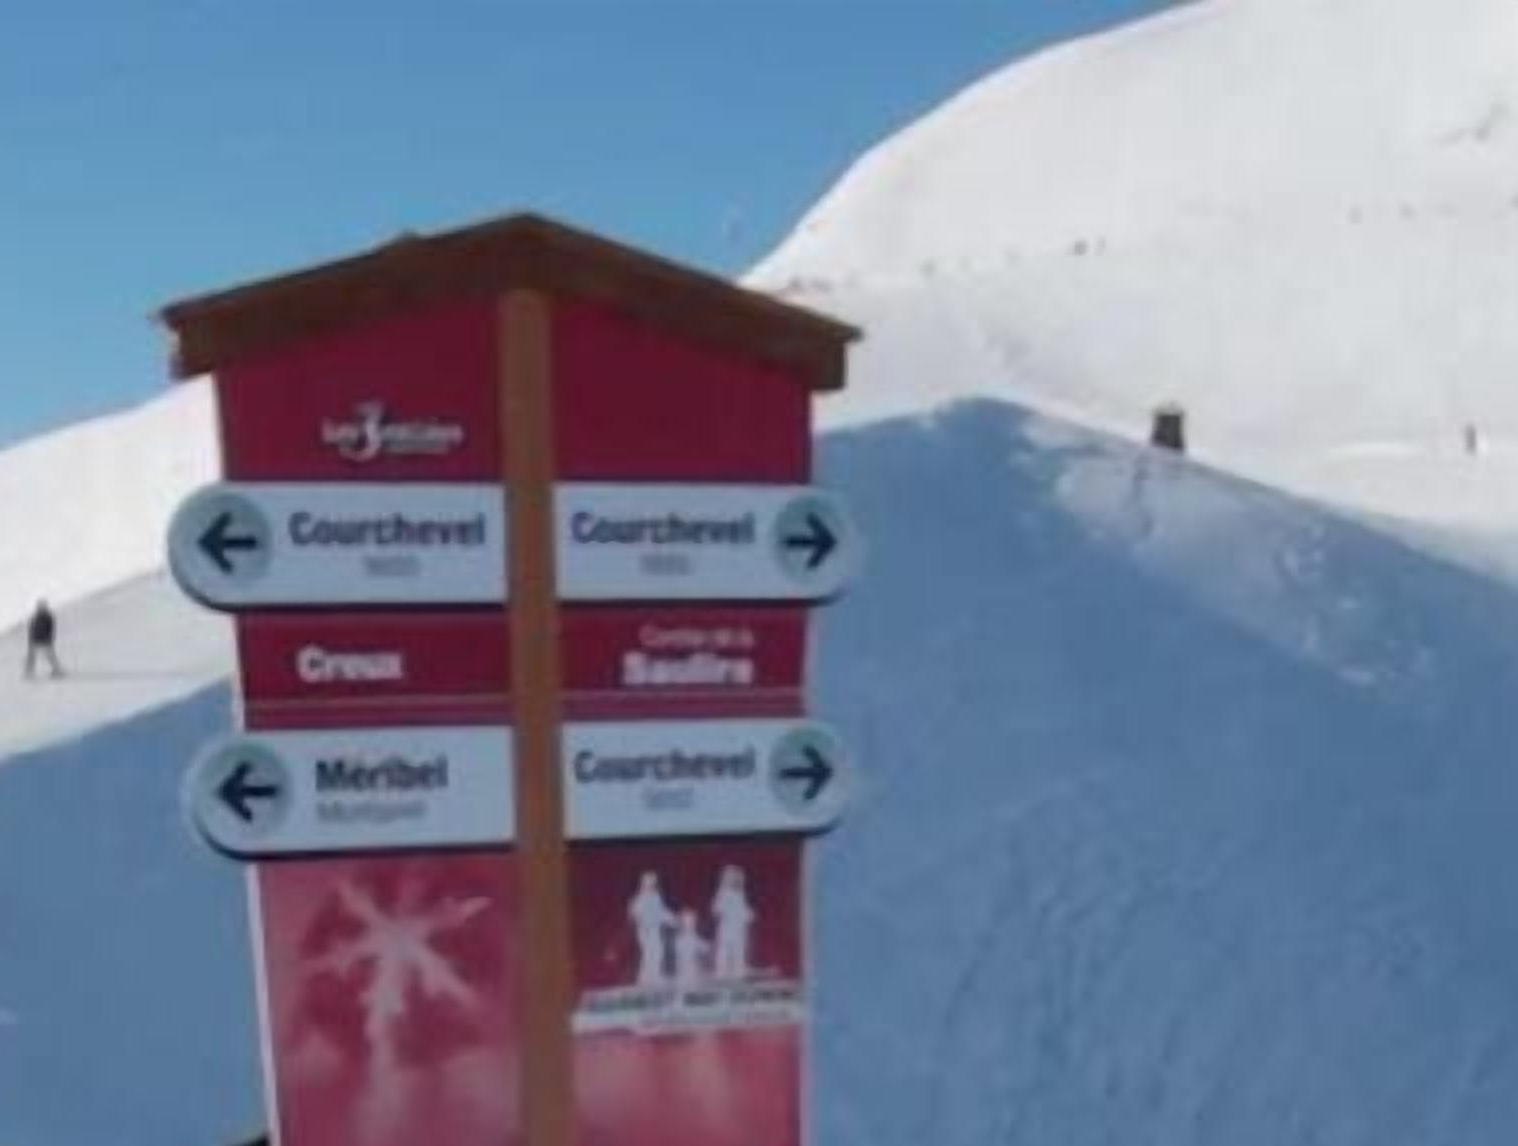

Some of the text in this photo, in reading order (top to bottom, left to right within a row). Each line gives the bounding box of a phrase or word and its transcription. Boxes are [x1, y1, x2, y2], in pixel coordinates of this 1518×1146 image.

[288, 512, 485, 545] Courchevel
[572, 512, 755, 543] Courchevel
[297, 646, 402, 682] Creux
[575, 747, 756, 783] Courchevel
